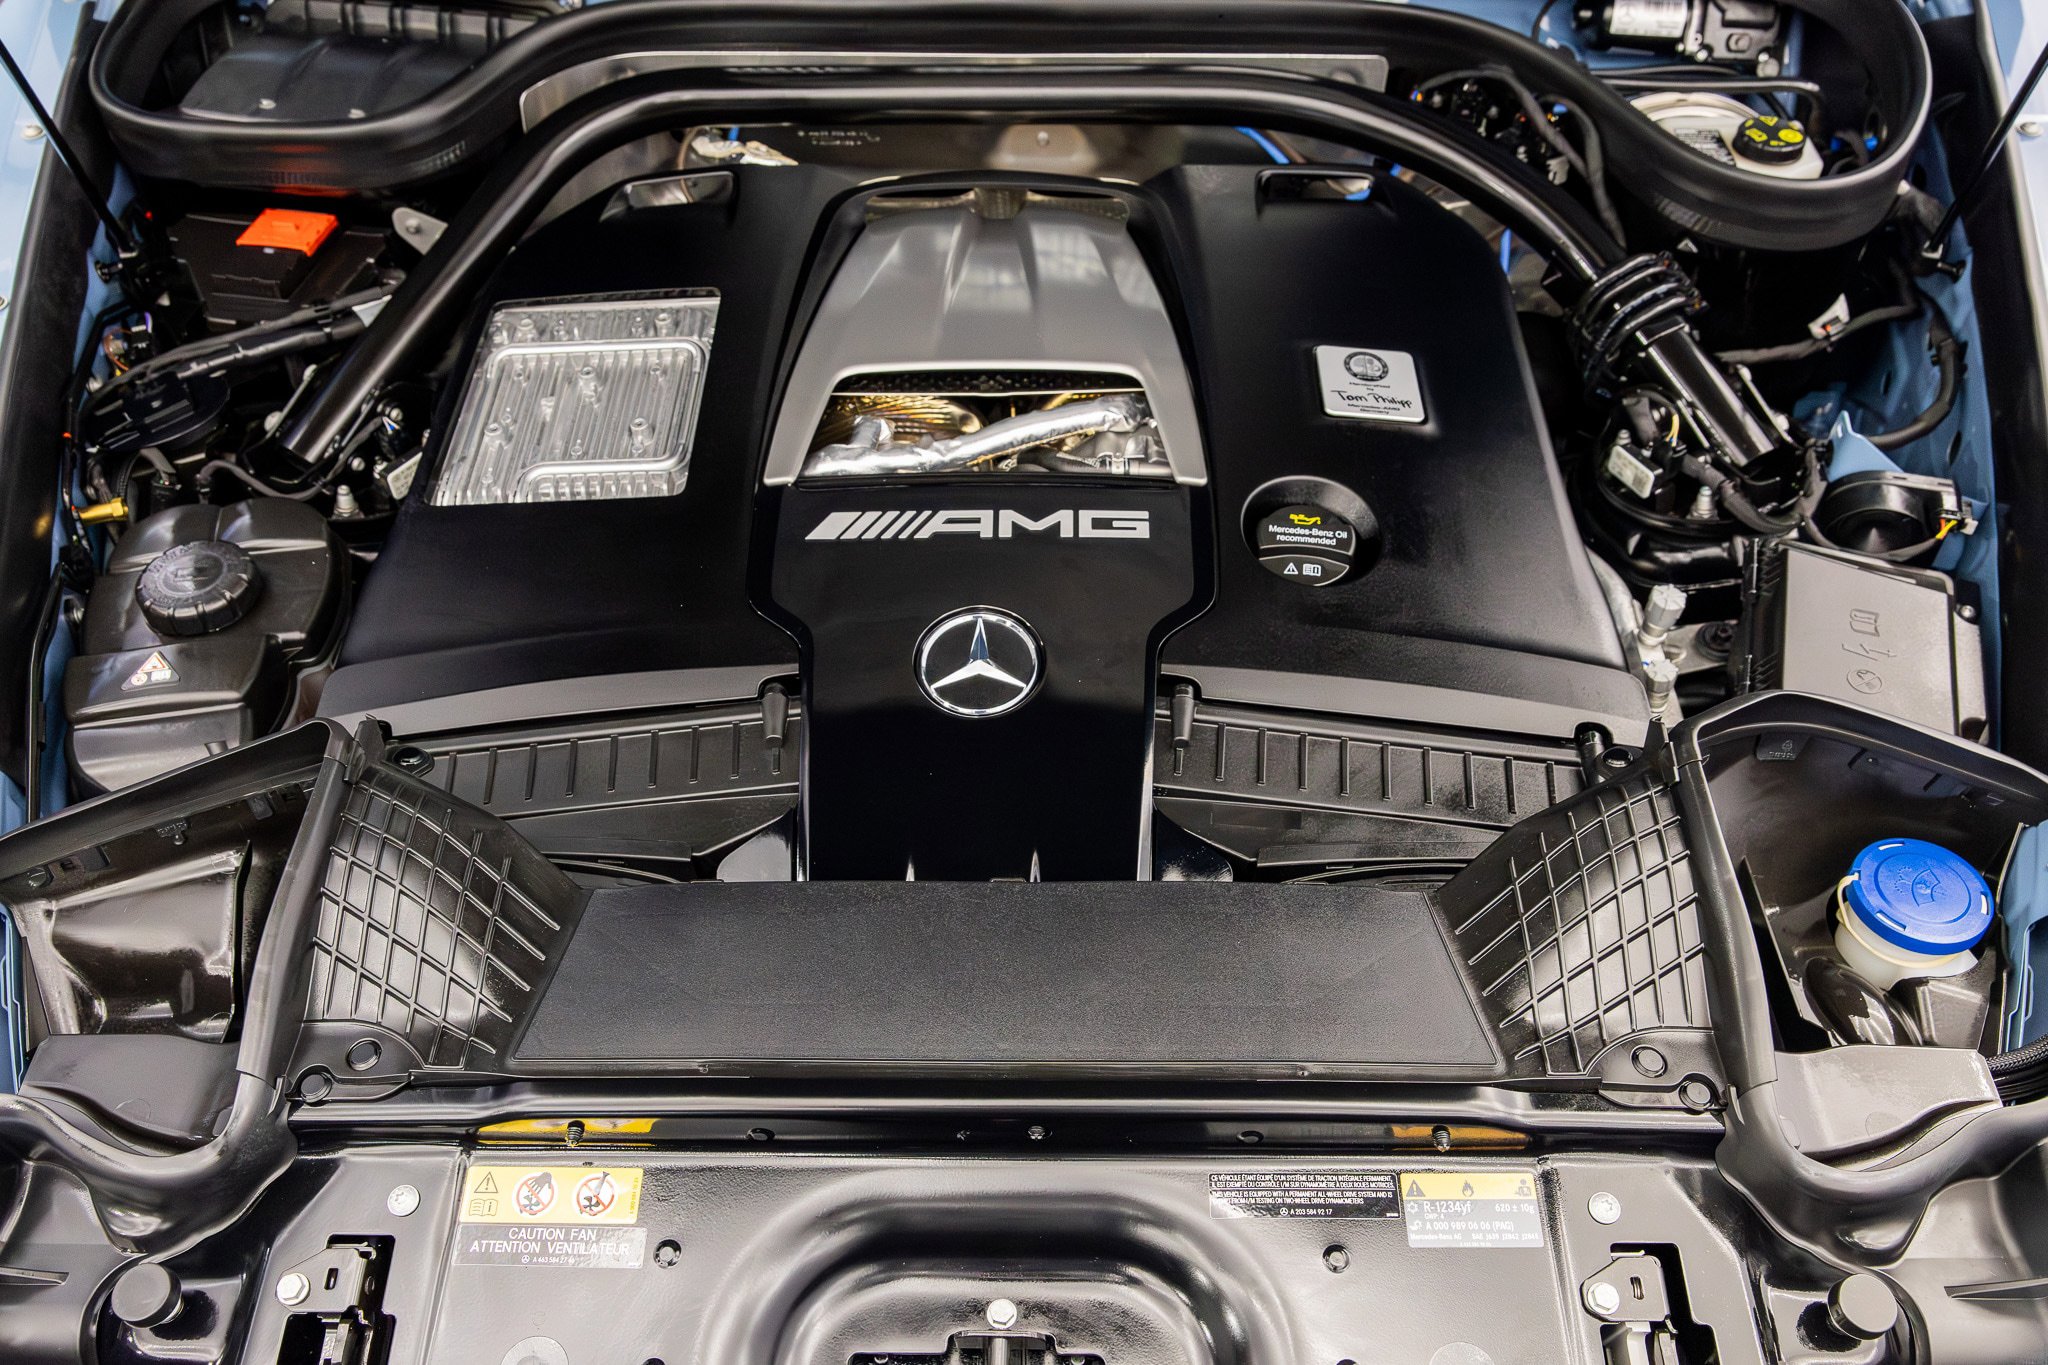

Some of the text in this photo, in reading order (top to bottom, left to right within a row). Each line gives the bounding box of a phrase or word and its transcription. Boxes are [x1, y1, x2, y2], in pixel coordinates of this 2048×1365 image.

[1330, 390, 1368, 402] Tom
[914, 509, 1150, 539] AMG
[1268, 524, 1347, 539] Mercedes-Benz Oil
[1276, 533, 1336, 546] recommended
[1423, 1201, 1471, 1216] R-1234yf
[1495, 1203, 1510, 1212] 620
[1520, 1203, 1535, 1214] 10g
[1426, 1220, 1514, 1232] A 000 989 06 06 (PAG)
[508, 1227, 597, 1241] CAUTION FAN
[470, 1240, 629, 1255] ATTENTION VENTILATEUR
